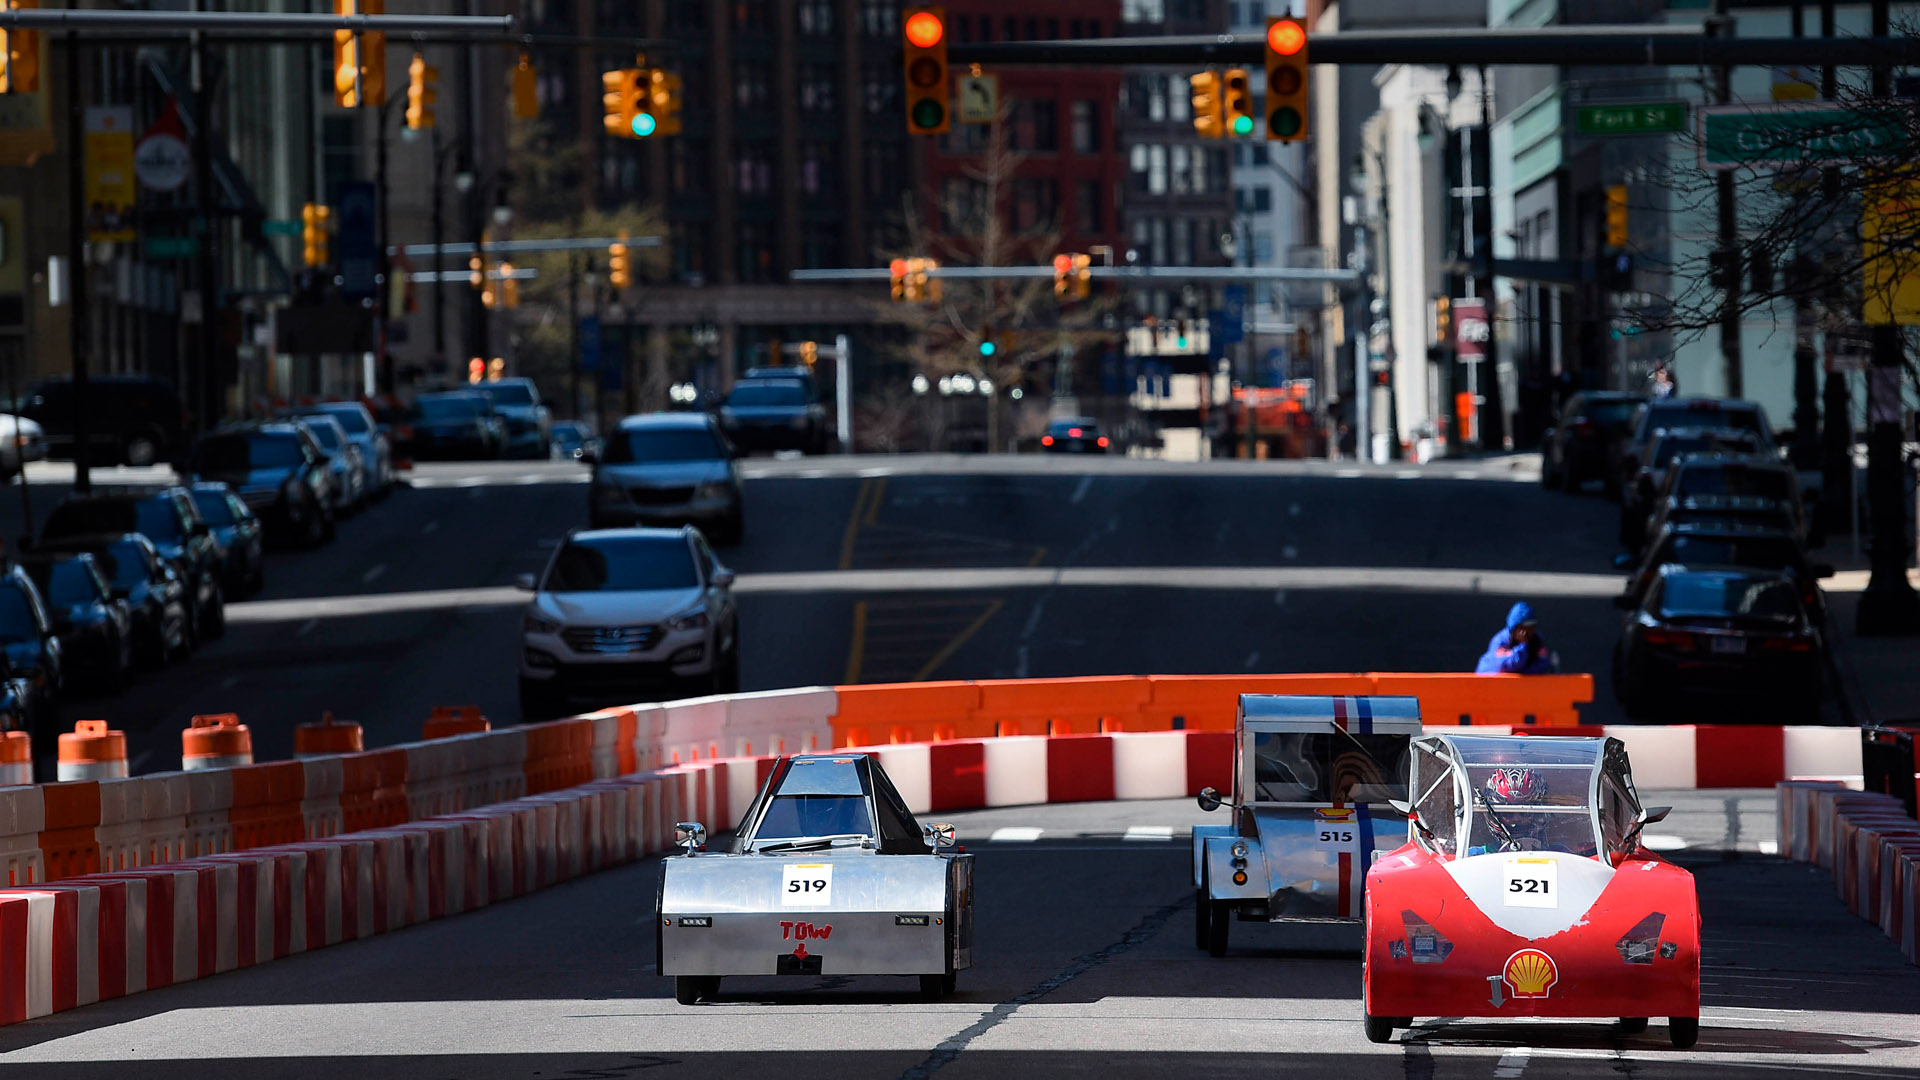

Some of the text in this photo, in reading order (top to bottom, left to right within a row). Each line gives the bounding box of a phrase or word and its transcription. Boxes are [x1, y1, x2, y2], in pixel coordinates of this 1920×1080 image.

[1593, 109, 1667, 127] Fort St
[1319, 831, 1353, 842] 515
[788, 879, 827, 893] 519
[1509, 879, 1549, 894] 521
[779, 920, 833, 941] TOW
